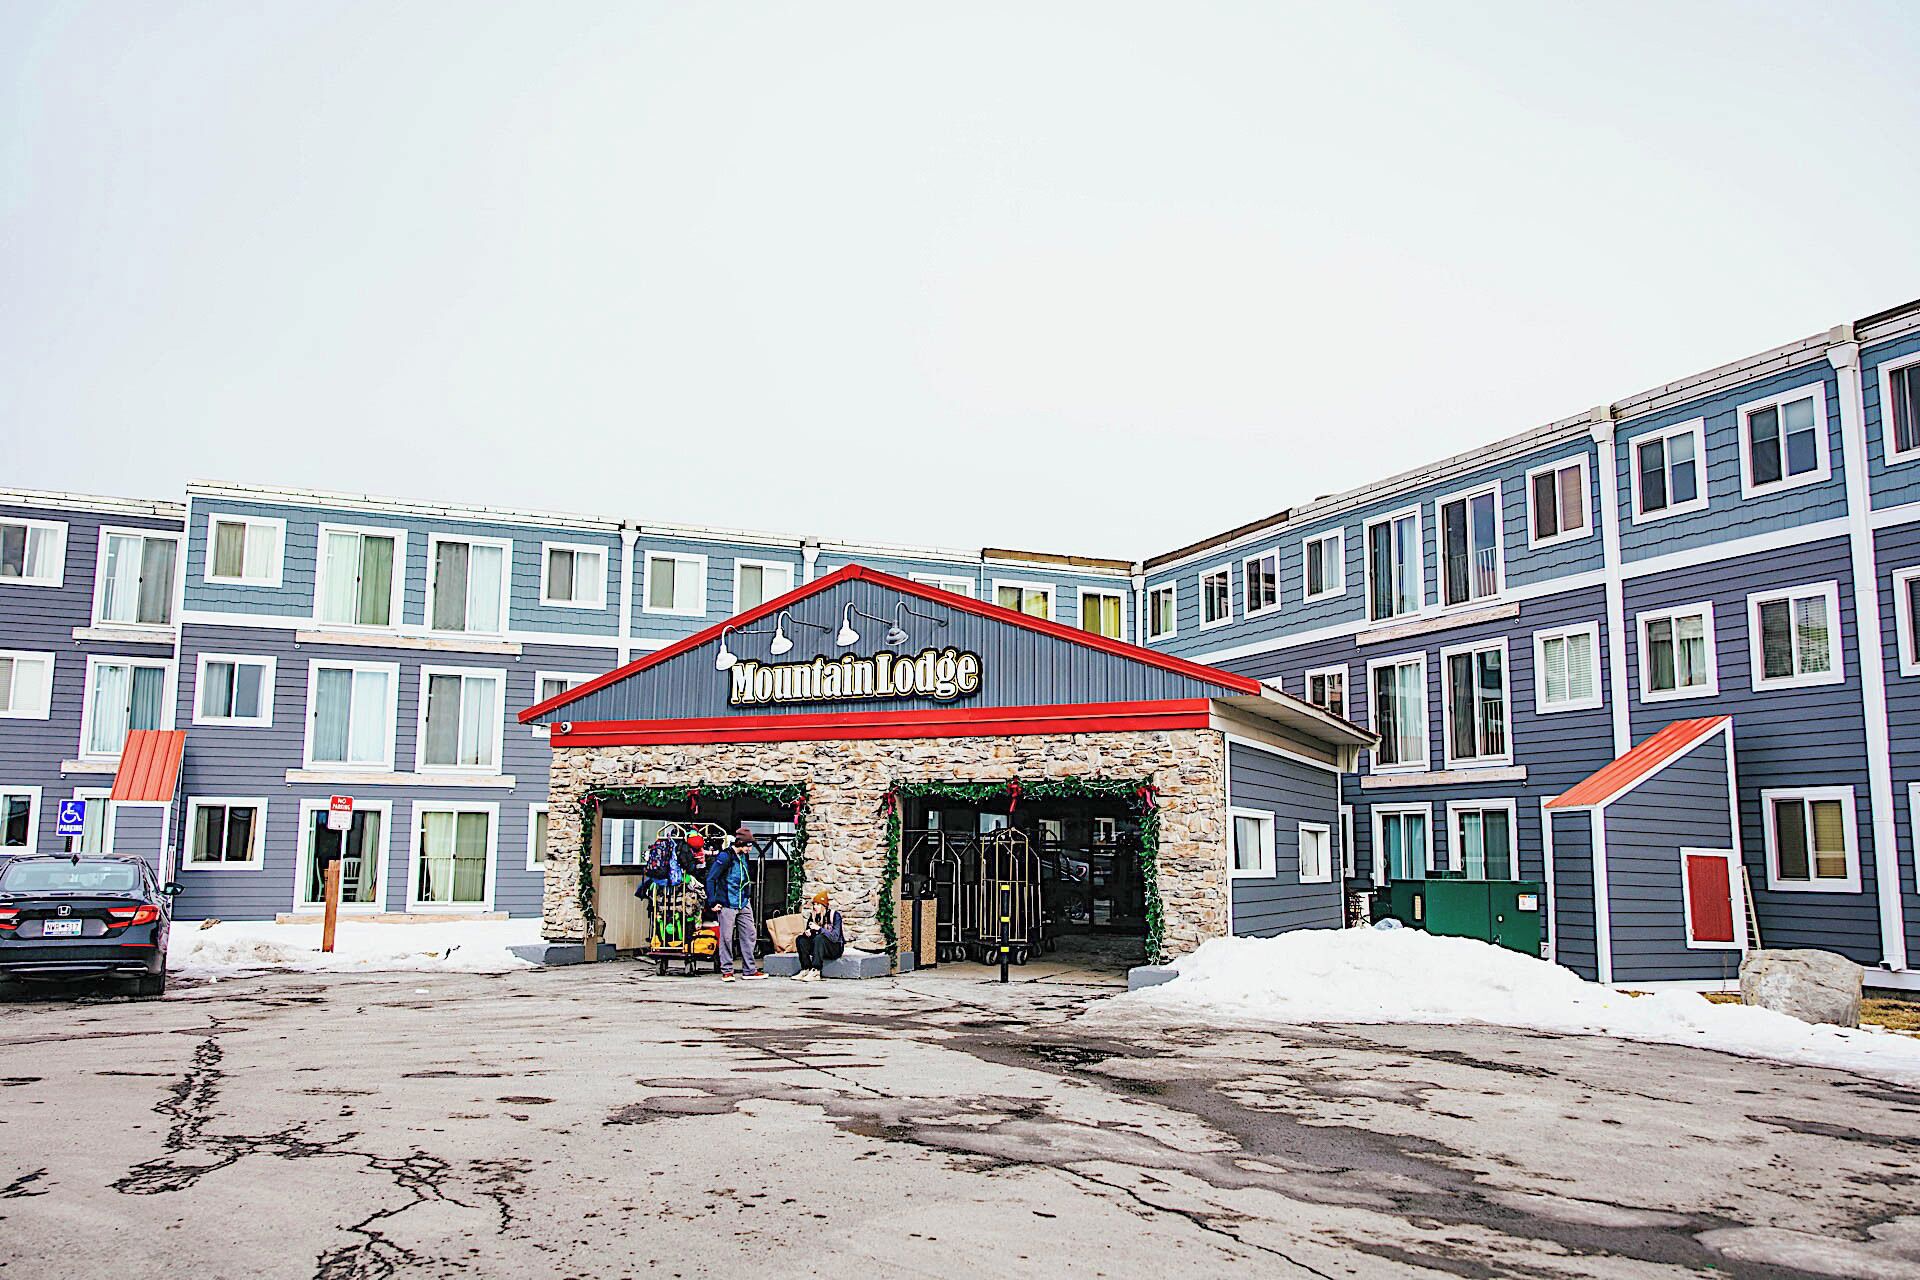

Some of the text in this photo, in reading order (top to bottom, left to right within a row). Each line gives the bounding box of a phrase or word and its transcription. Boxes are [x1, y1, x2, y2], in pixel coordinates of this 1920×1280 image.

[731, 649, 979, 703] Mountain Lodge
[59, 824, 83, 832] PARKING
